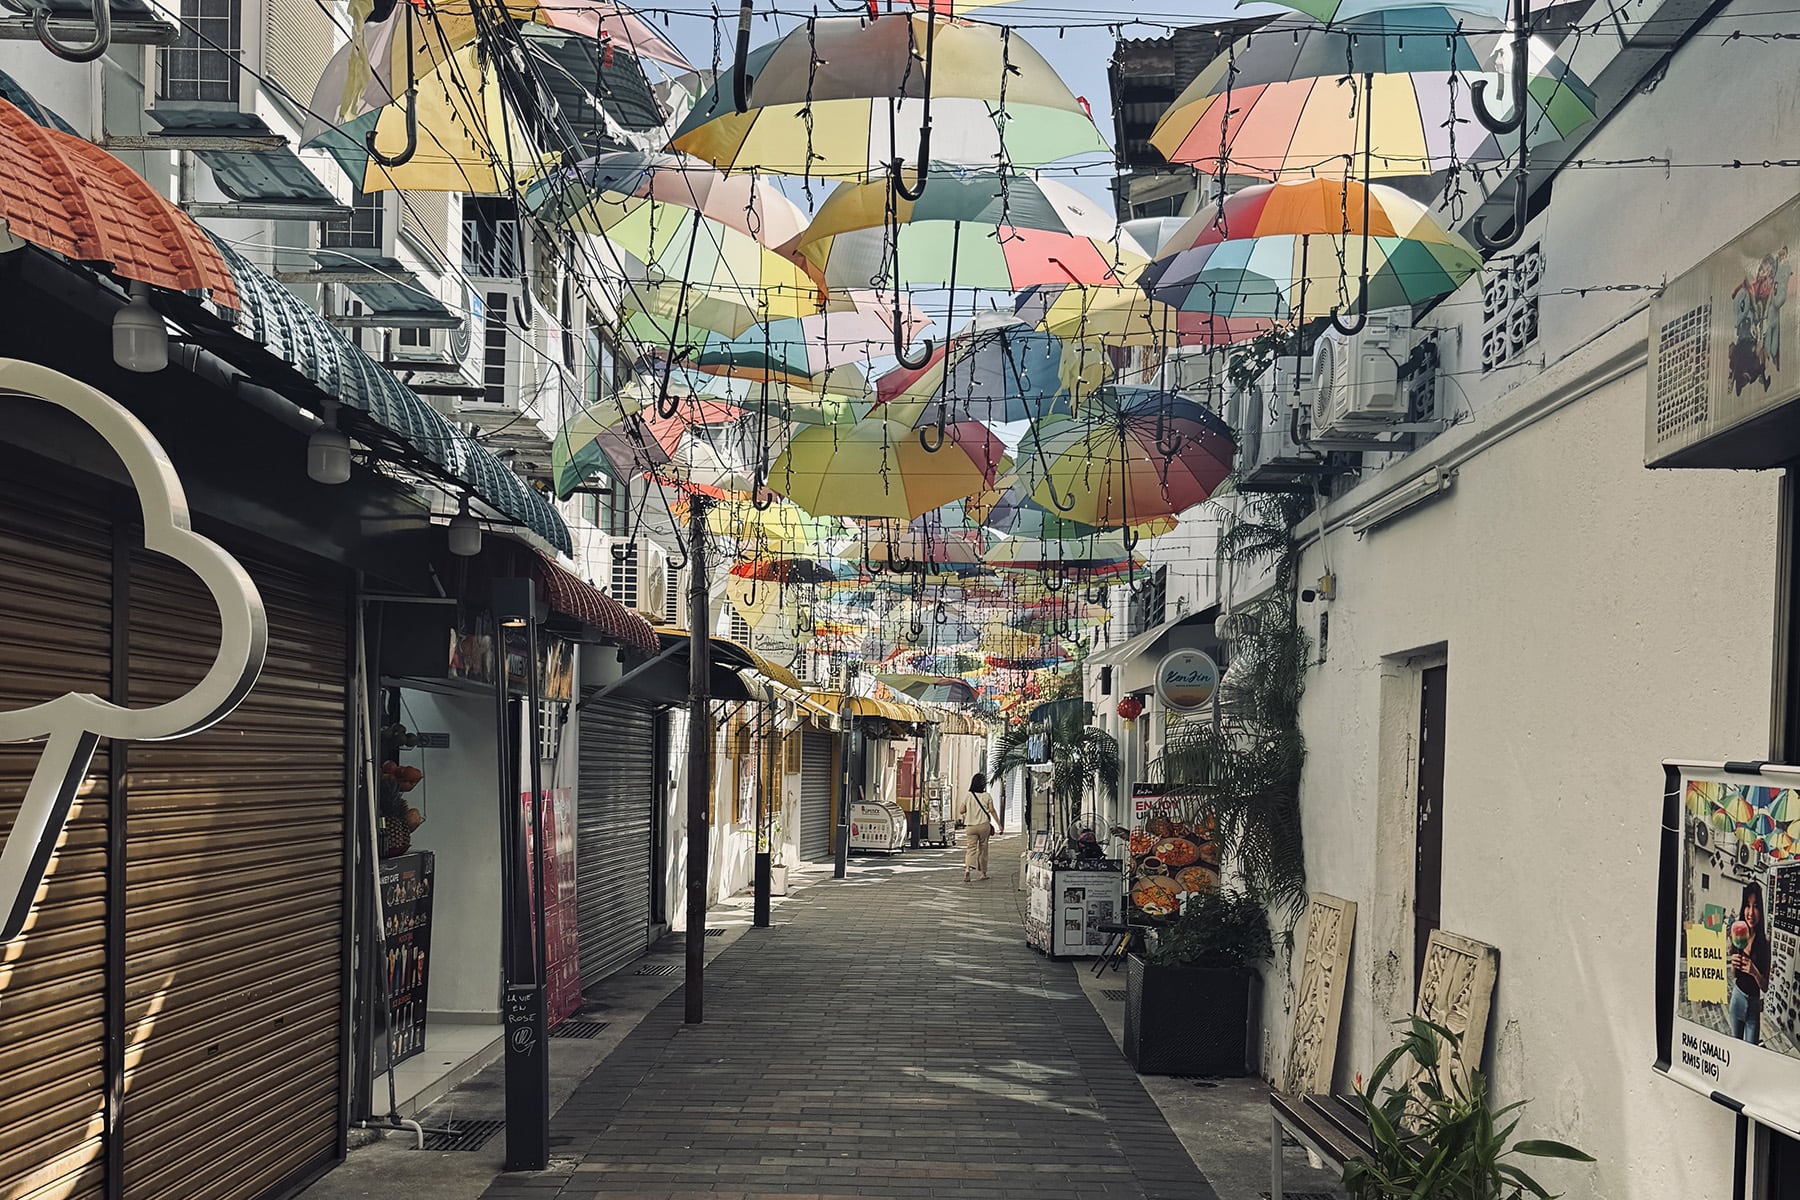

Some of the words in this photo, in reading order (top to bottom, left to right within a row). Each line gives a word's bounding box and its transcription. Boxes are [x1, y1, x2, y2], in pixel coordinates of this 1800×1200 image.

[1690, 946, 1702, 959] ICE
[1703, 947, 1722, 960] BALL
[1688, 966, 1700, 979] AIS
[1701, 967, 1725, 981] KEPAL
[507, 994, 517, 1002] LA
[518, 993, 533, 1002] VIE
[508, 1013, 537, 1023] ROSE
[1681, 1032, 1698, 1051] RM6
[1699, 1039, 1731, 1067] (SMALL)
[1681, 1050, 1701, 1070] RM15
[1701, 1058, 1720, 1082] (BIG)
